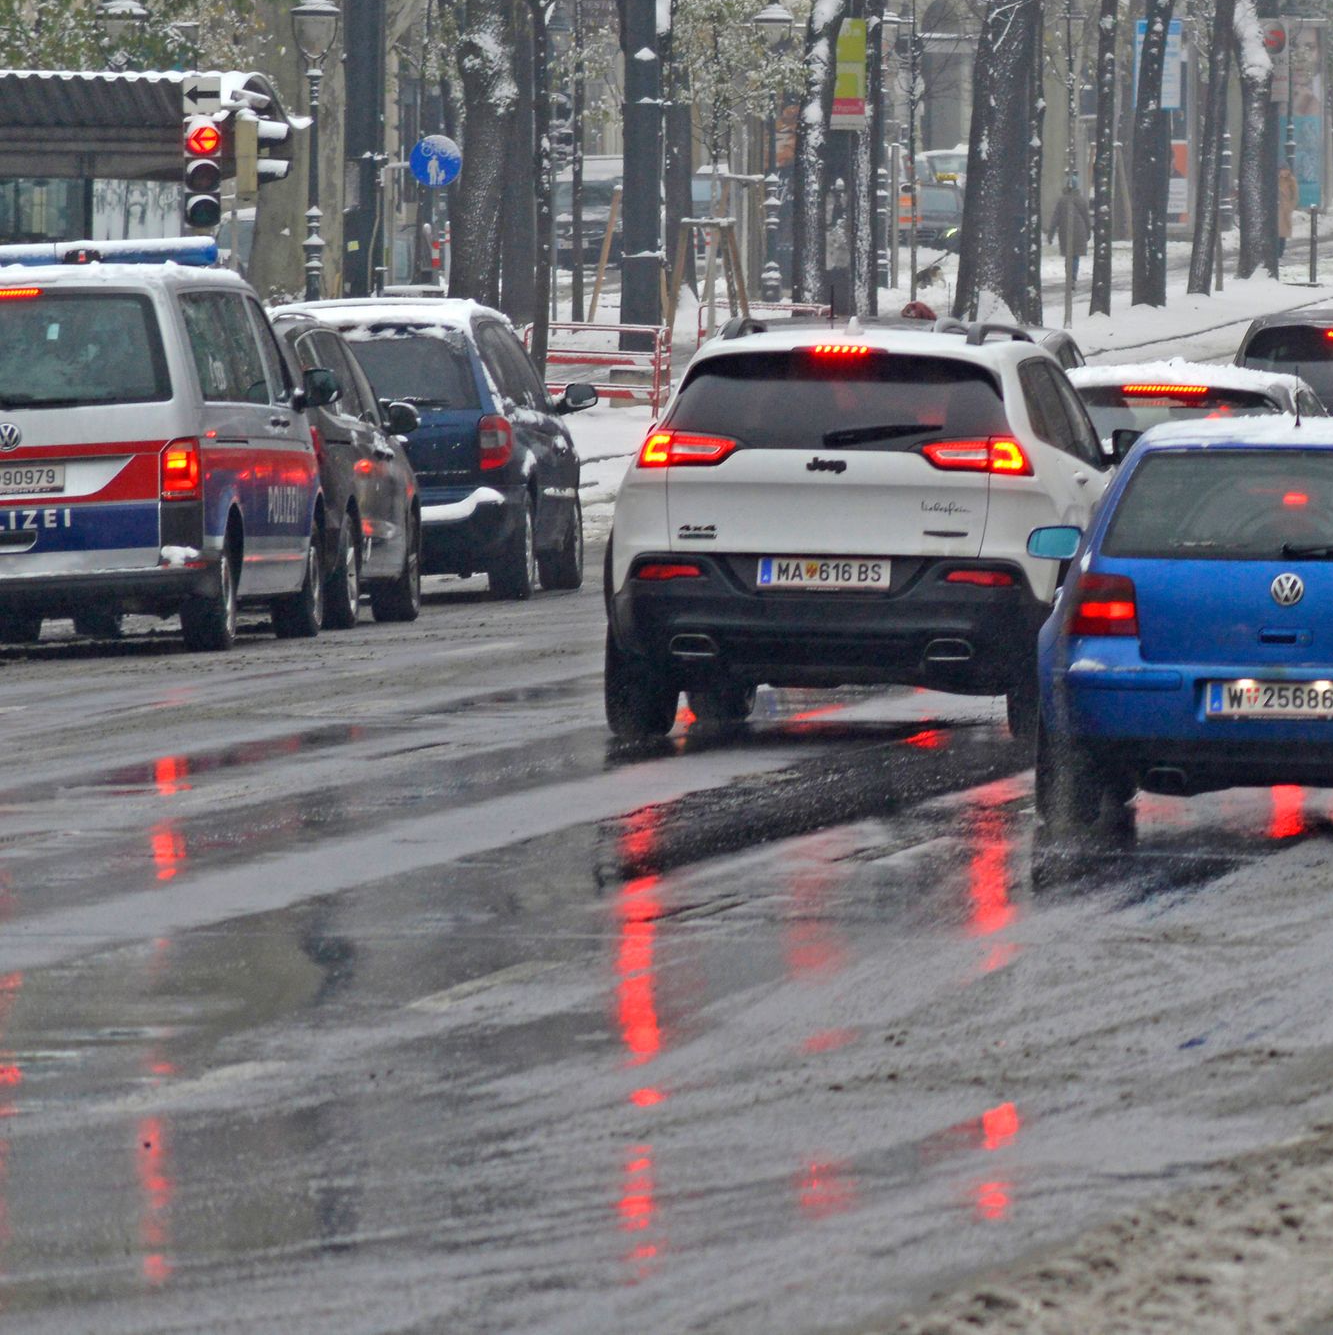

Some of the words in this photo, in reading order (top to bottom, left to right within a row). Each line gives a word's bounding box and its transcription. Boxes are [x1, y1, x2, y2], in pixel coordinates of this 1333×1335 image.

[806, 456, 848, 475] Jeep
[776, 563, 804, 582] MA
[818, 563, 852, 583] 616
[857, 565, 882, 583] BS
[1227, 686, 1244, 709] W
